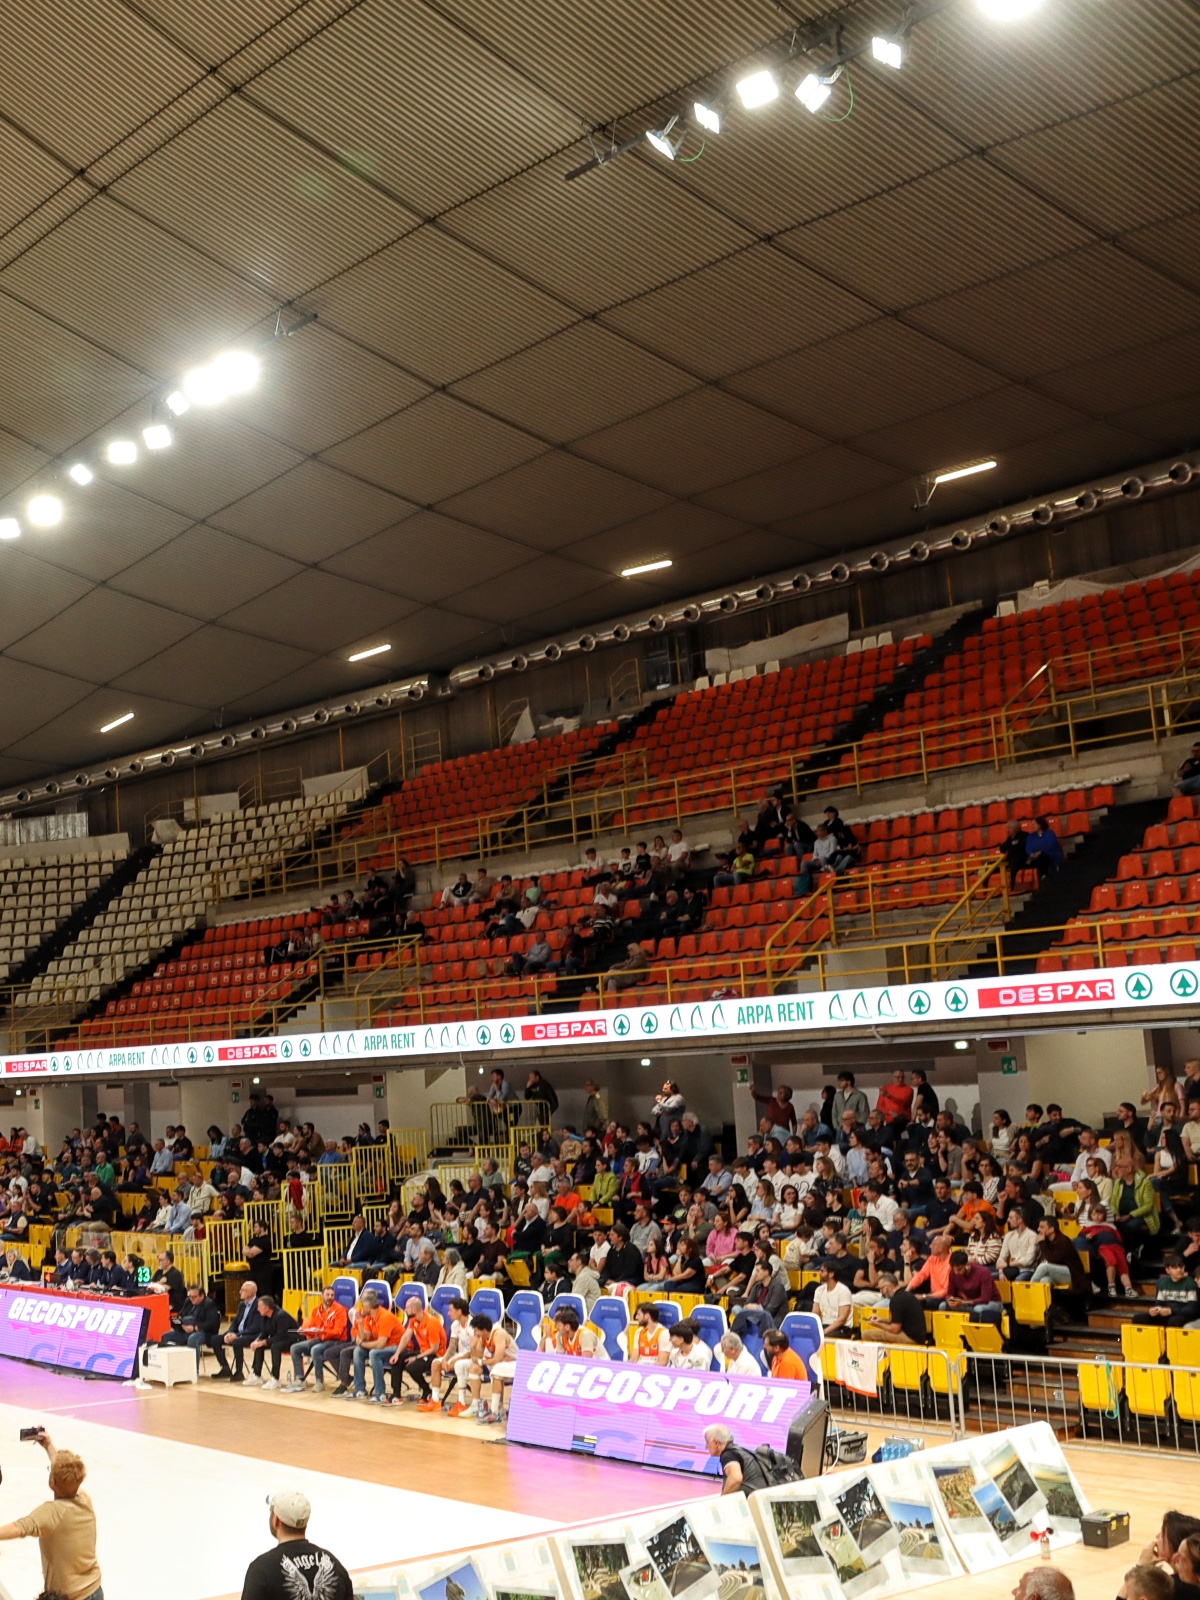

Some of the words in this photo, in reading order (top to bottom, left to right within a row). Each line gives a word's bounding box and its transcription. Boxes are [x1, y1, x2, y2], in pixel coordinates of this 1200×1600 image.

[999, 982, 1113, 1004] DESPAR
[738, 1006, 773, 1025] ARPA
[778, 1001, 814, 1022] RENT
[535, 1023, 606, 1038] DESPAR
[364, 1036, 387, 1051] ARPA
[391, 1032, 415, 1048] RENT
[109, 1054, 126, 1066] ARPA
[128, 1052, 145, 1065] RENT
[227, 1048, 276, 1059] DESPAR
[12, 1062, 47, 1071] DESPAR
[8, 1297, 136, 1336] GECOSPORT
[527, 1360, 798, 1423] GECOSPORT
